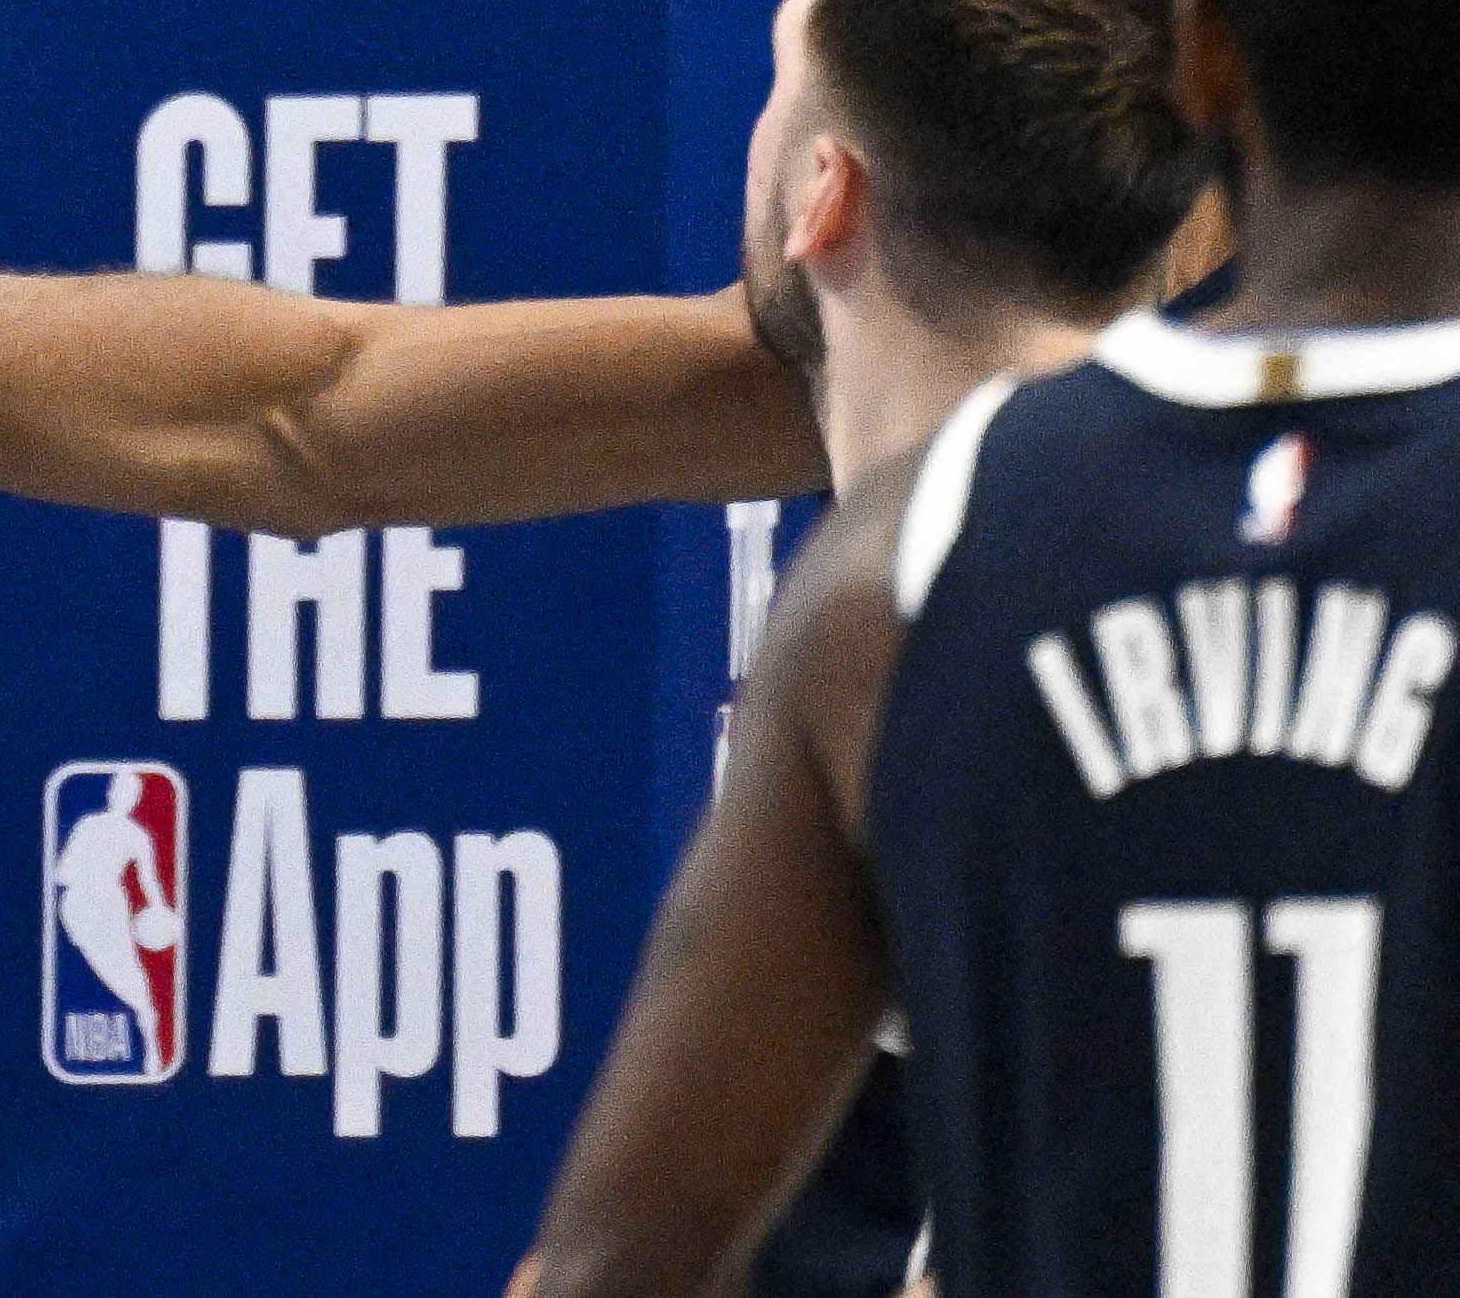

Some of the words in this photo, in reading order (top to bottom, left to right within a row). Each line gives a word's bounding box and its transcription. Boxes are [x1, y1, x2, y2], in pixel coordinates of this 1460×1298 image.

[1025, 573, 1460, 800] IRVING
[207, 765, 563, 1139] App
[1116, 893, 1386, 1298] 11
